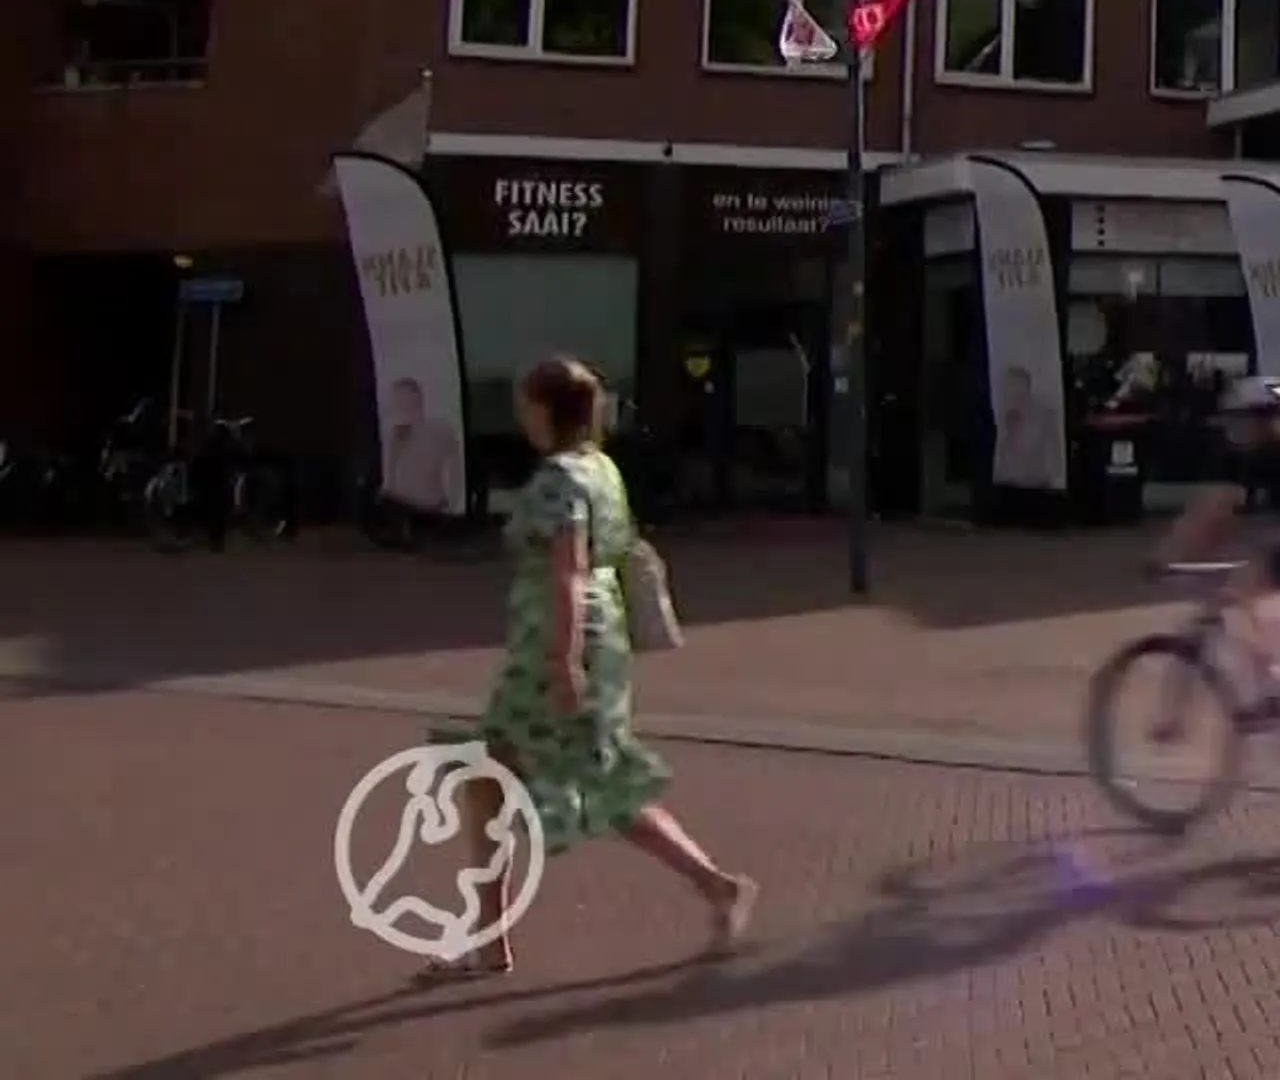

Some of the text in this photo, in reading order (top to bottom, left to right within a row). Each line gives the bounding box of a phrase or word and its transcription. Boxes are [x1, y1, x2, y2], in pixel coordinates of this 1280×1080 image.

[495, 178, 603, 208] FITNESS
[712, 193, 741, 208] en
[747, 191, 767, 210] te
[508, 209, 587, 237] SAAI?
